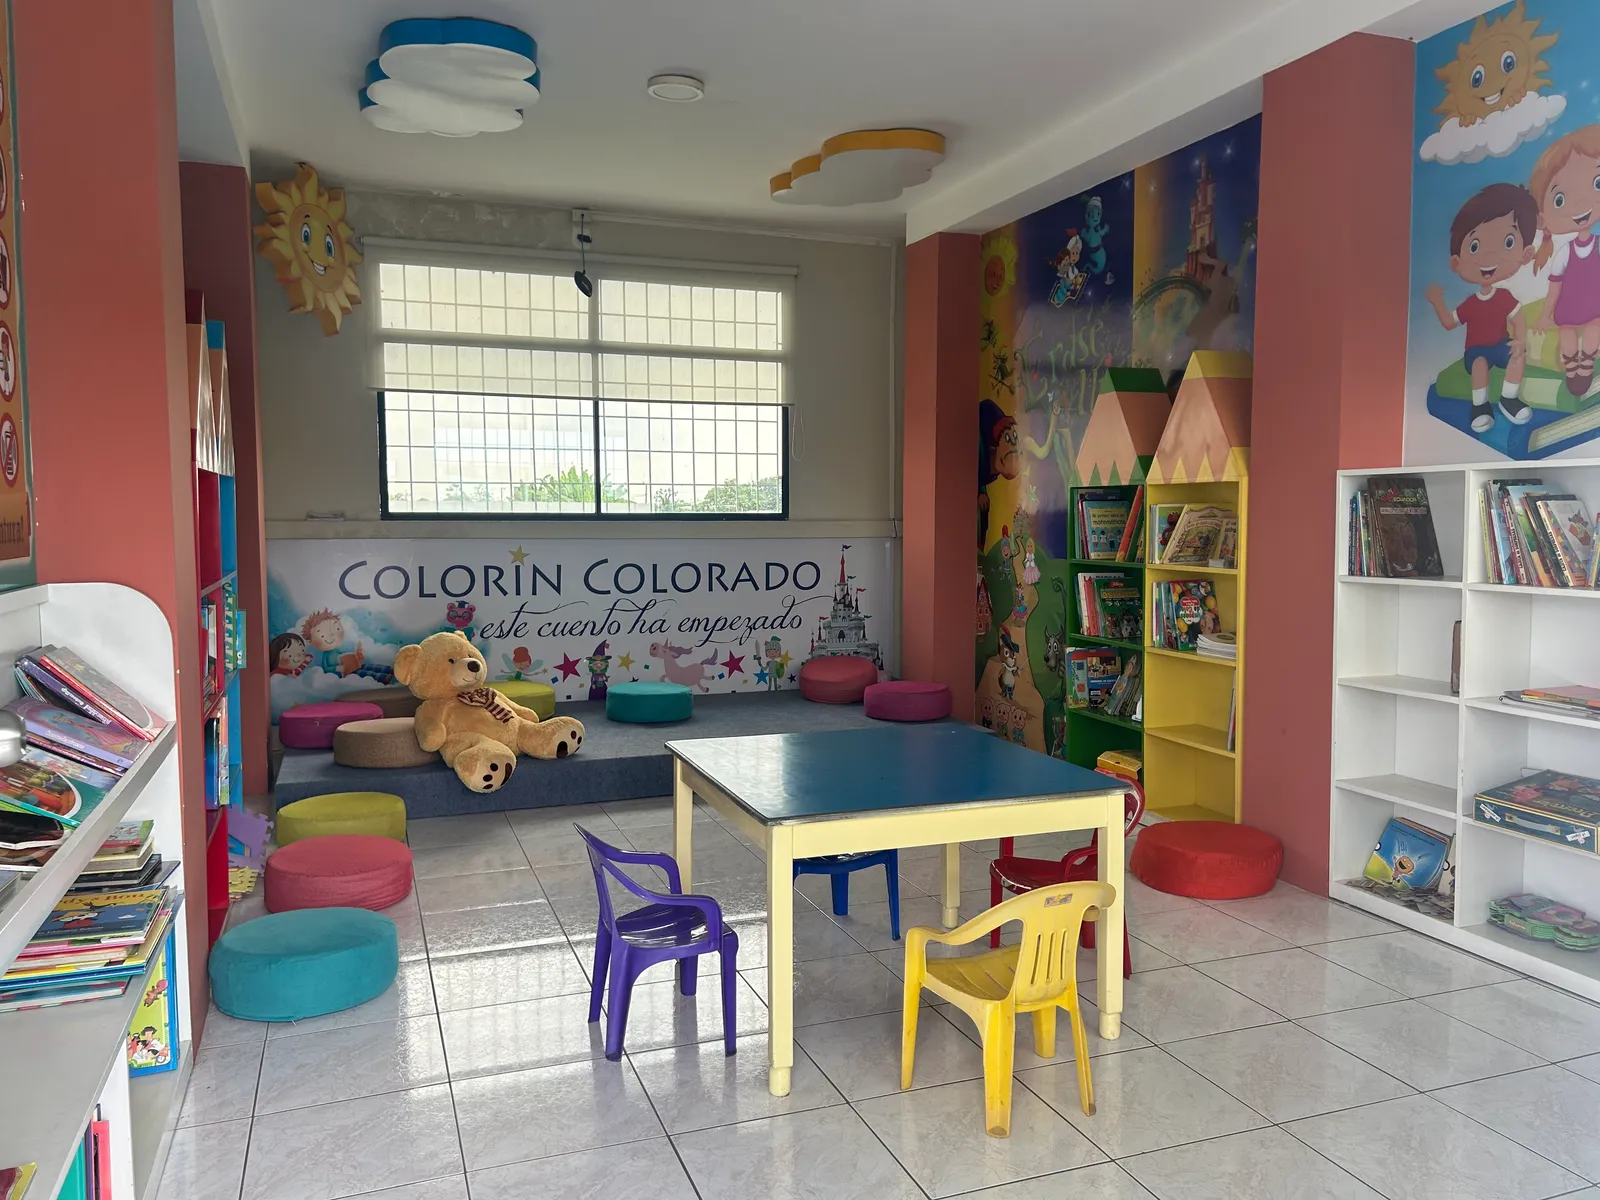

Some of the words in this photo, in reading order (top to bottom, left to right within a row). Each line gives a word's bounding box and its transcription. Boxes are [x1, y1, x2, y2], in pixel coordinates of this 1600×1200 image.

[583, 558, 821, 595] COLORADO
[479, 600, 543, 640] este
[537, 598, 622, 637] cuento
[677, 595, 804, 648] empezado
